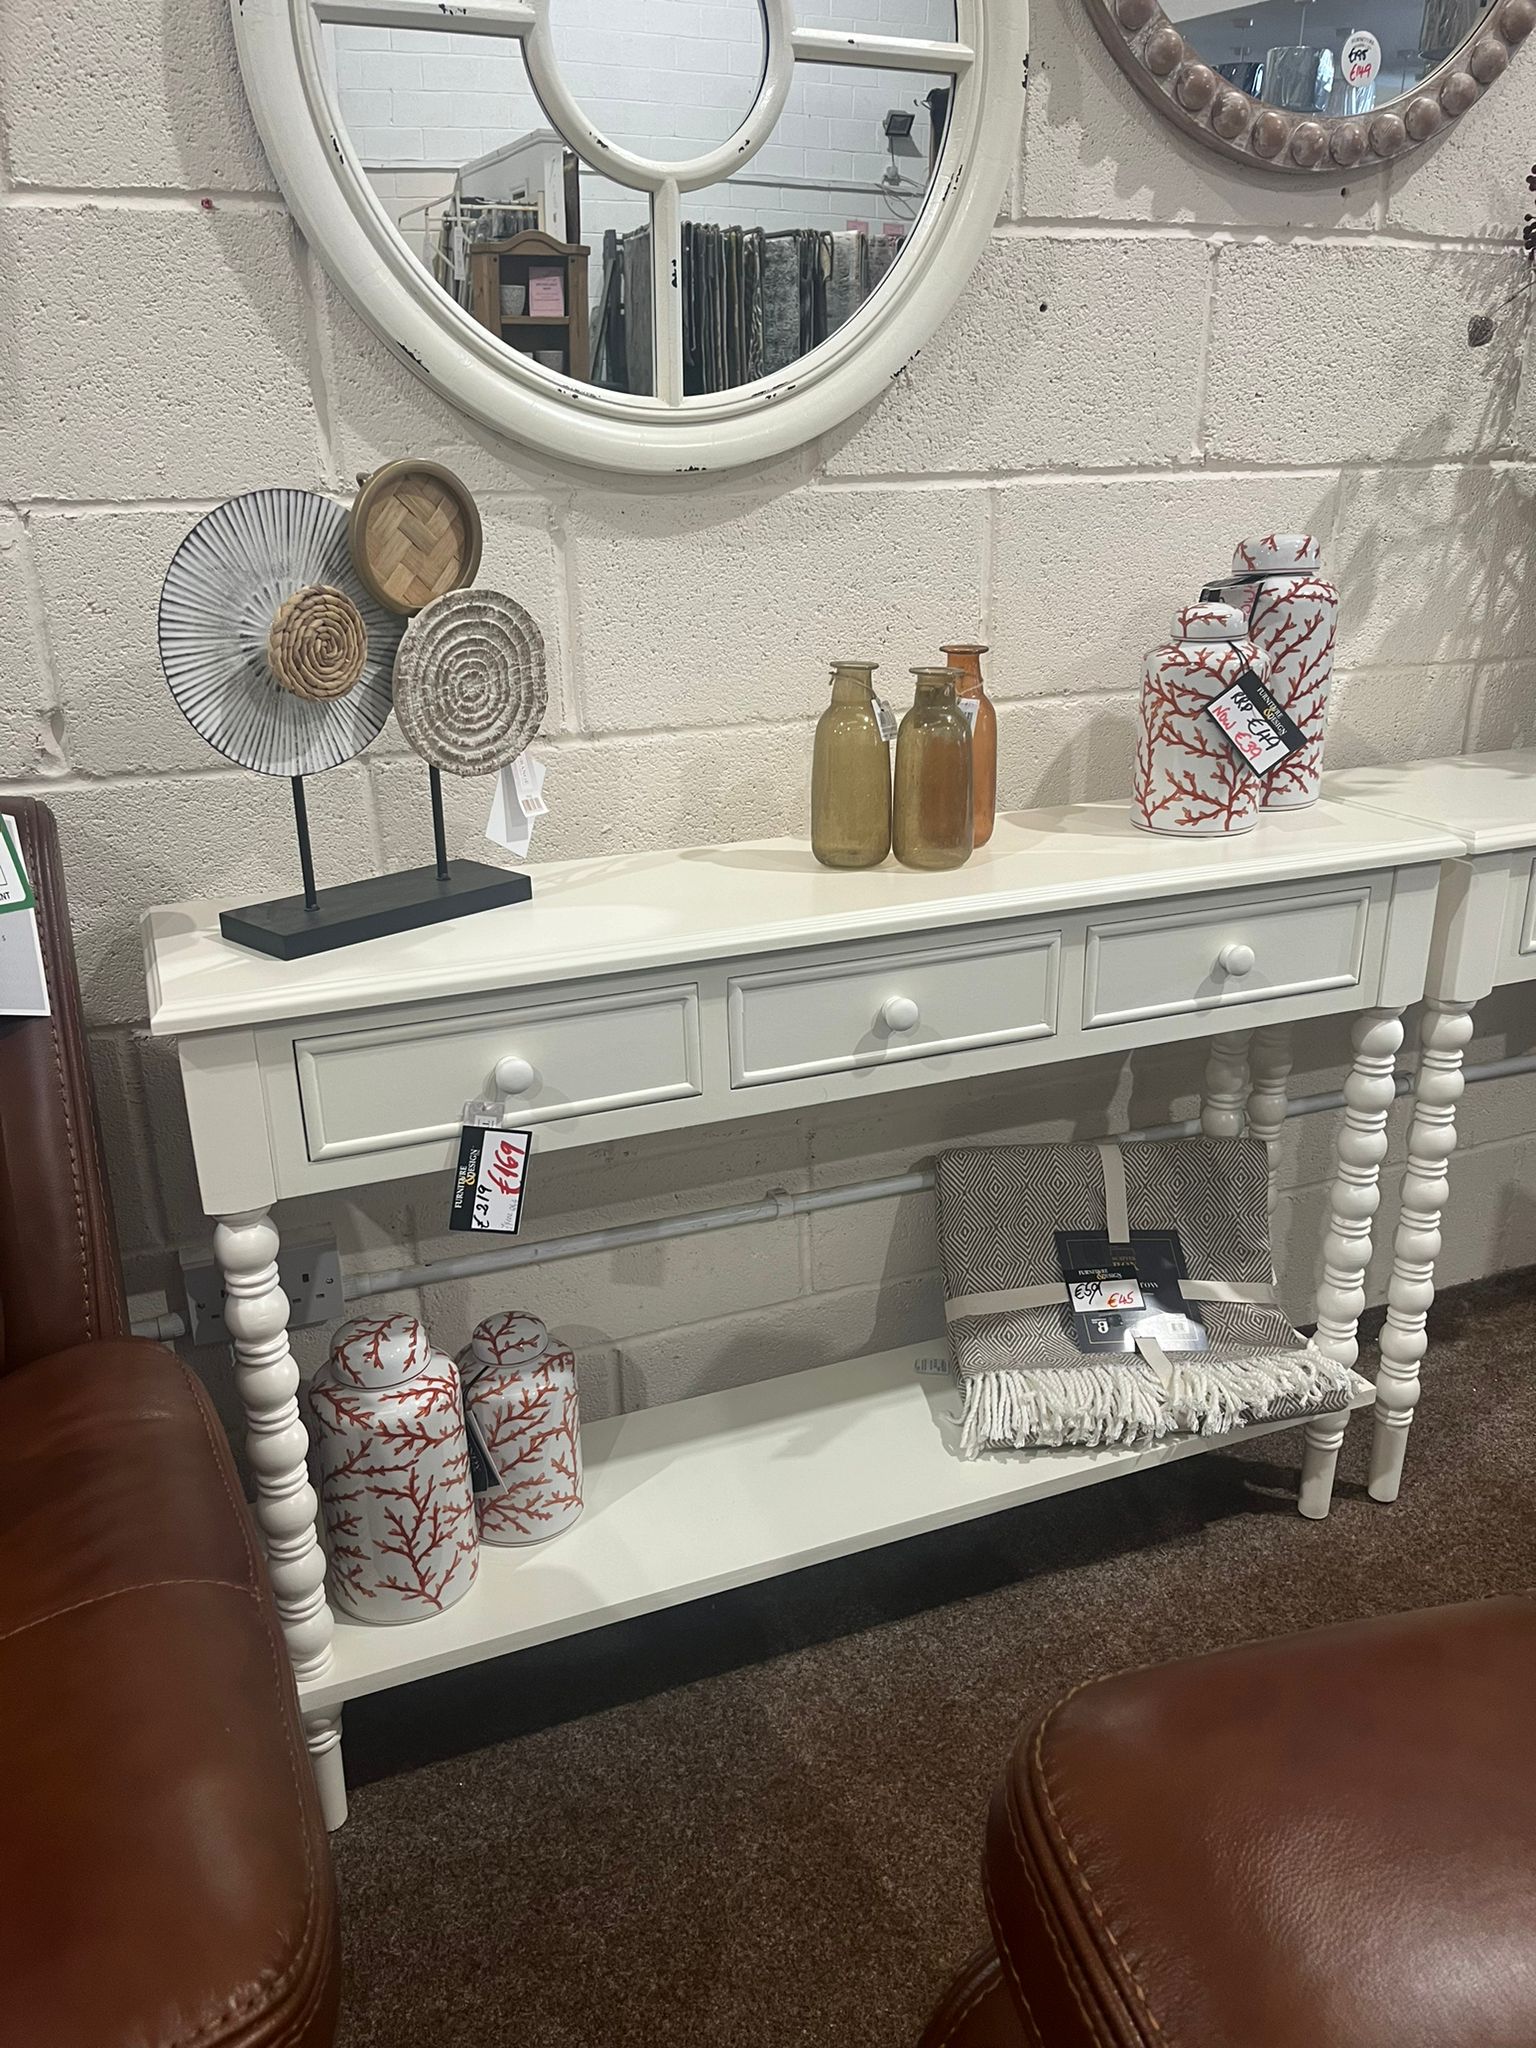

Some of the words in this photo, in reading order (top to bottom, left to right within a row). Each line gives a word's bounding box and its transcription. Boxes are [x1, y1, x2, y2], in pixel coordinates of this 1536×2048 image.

[1256, 686, 1284, 719] FURNITURE
[454, 1165, 468, 1209] FURNITURE
[1107, 1291, 1134, 1308] €45
